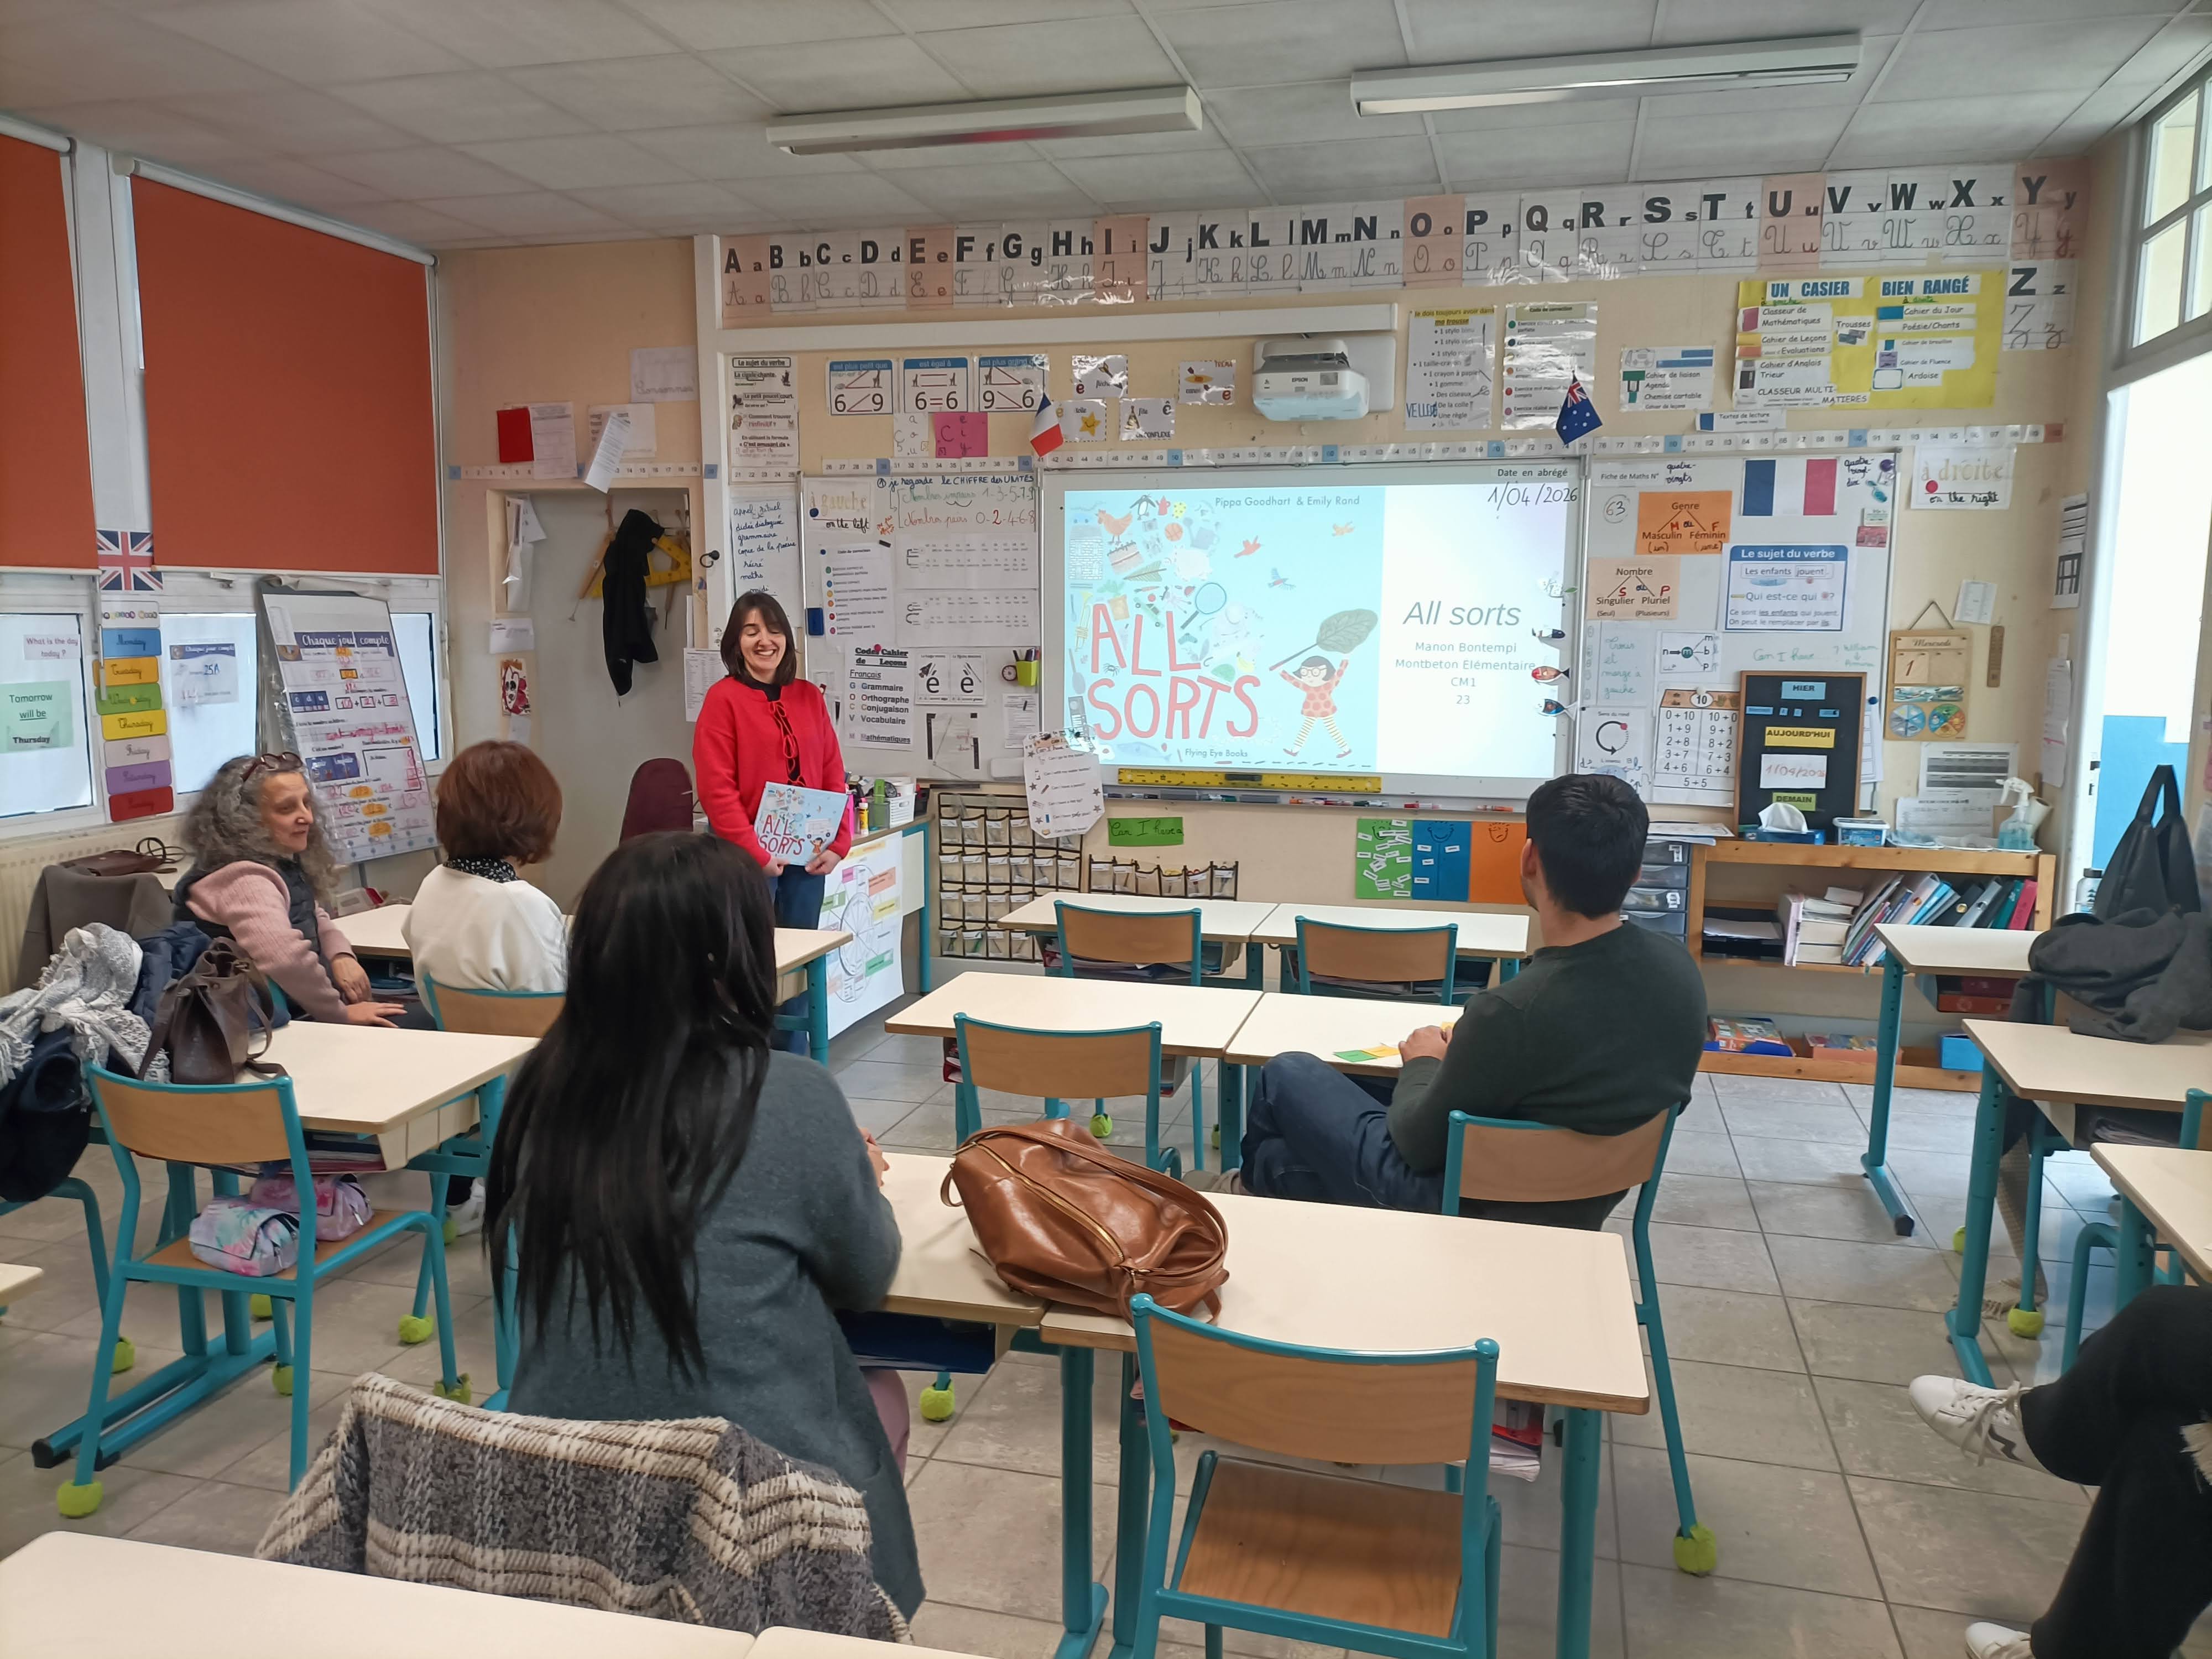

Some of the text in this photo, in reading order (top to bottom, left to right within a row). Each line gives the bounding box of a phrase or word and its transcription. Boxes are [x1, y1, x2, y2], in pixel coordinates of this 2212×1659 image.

[1771, 275, 1969, 298] UN CASIER BIEN RANGÉ
[1762, 307, 1795, 316] Classeur
[1762, 317, 1820, 327] Mathématiques
[1902, 322, 1959, 331] Poésie/Chants
[1801, 335, 1827, 343] Leçons
[1787, 360, 1822, 368] d'Anglais
[1758, 387, 1801, 395] CLASSEUR
[834, 393, 884, 413] 6 9
[915, 390, 958, 410] 6 6
[1822, 395, 1867, 404] MATIERES
[1498, 468, 1517, 477] Date
[1537, 467, 1568, 478] abrégé
[901, 477, 933, 490] regarde
[941, 475, 953, 485] le
[1215, 496, 1360, 508] Pippa Goodhart & Emily Rand
[1949, 492, 1965, 503] the
[1971, 492, 2000, 506] right
[853, 518, 869, 533] left
[1689, 531, 1726, 539] Féminin
[1741, 549, 1835, 560] Le sujet du verbe
[740, 571, 763, 580] maths
[1796, 568, 1824, 577] jouent
[1596, 597, 1635, 606] Singulier
[1402, 600, 1521, 626] All sorts
[1091, 603, 1201, 676] ALL
[1912, 639, 1952, 647] Mercredi
[1415, 642, 1516, 654] Manon Bontempi
[41, 650, 60, 659] today
[1396, 659, 1458, 669] Montbeton
[850, 669, 881, 679] Français
[926, 669, 974, 693] é è
[1451, 677, 1477, 686] CM1
[862, 682, 903, 692] Grammaire
[9, 694, 53, 703] Tomorrow
[862, 694, 909, 704] Orthographe
[1456, 695, 1470, 704] 23
[1697, 696, 1707, 704] 10
[861, 705, 909, 713] Conjugaison
[1087, 675, 1261, 740] SORTS
[19, 709, 46, 718] will be
[861, 715, 906, 724] Vocabulaire
[860, 733, 911, 743] Mathématiques
[1185, 748, 1248, 759] Flying Eye Books
[763, 815, 791, 836] ALL
[759, 835, 805, 855] SORTS
